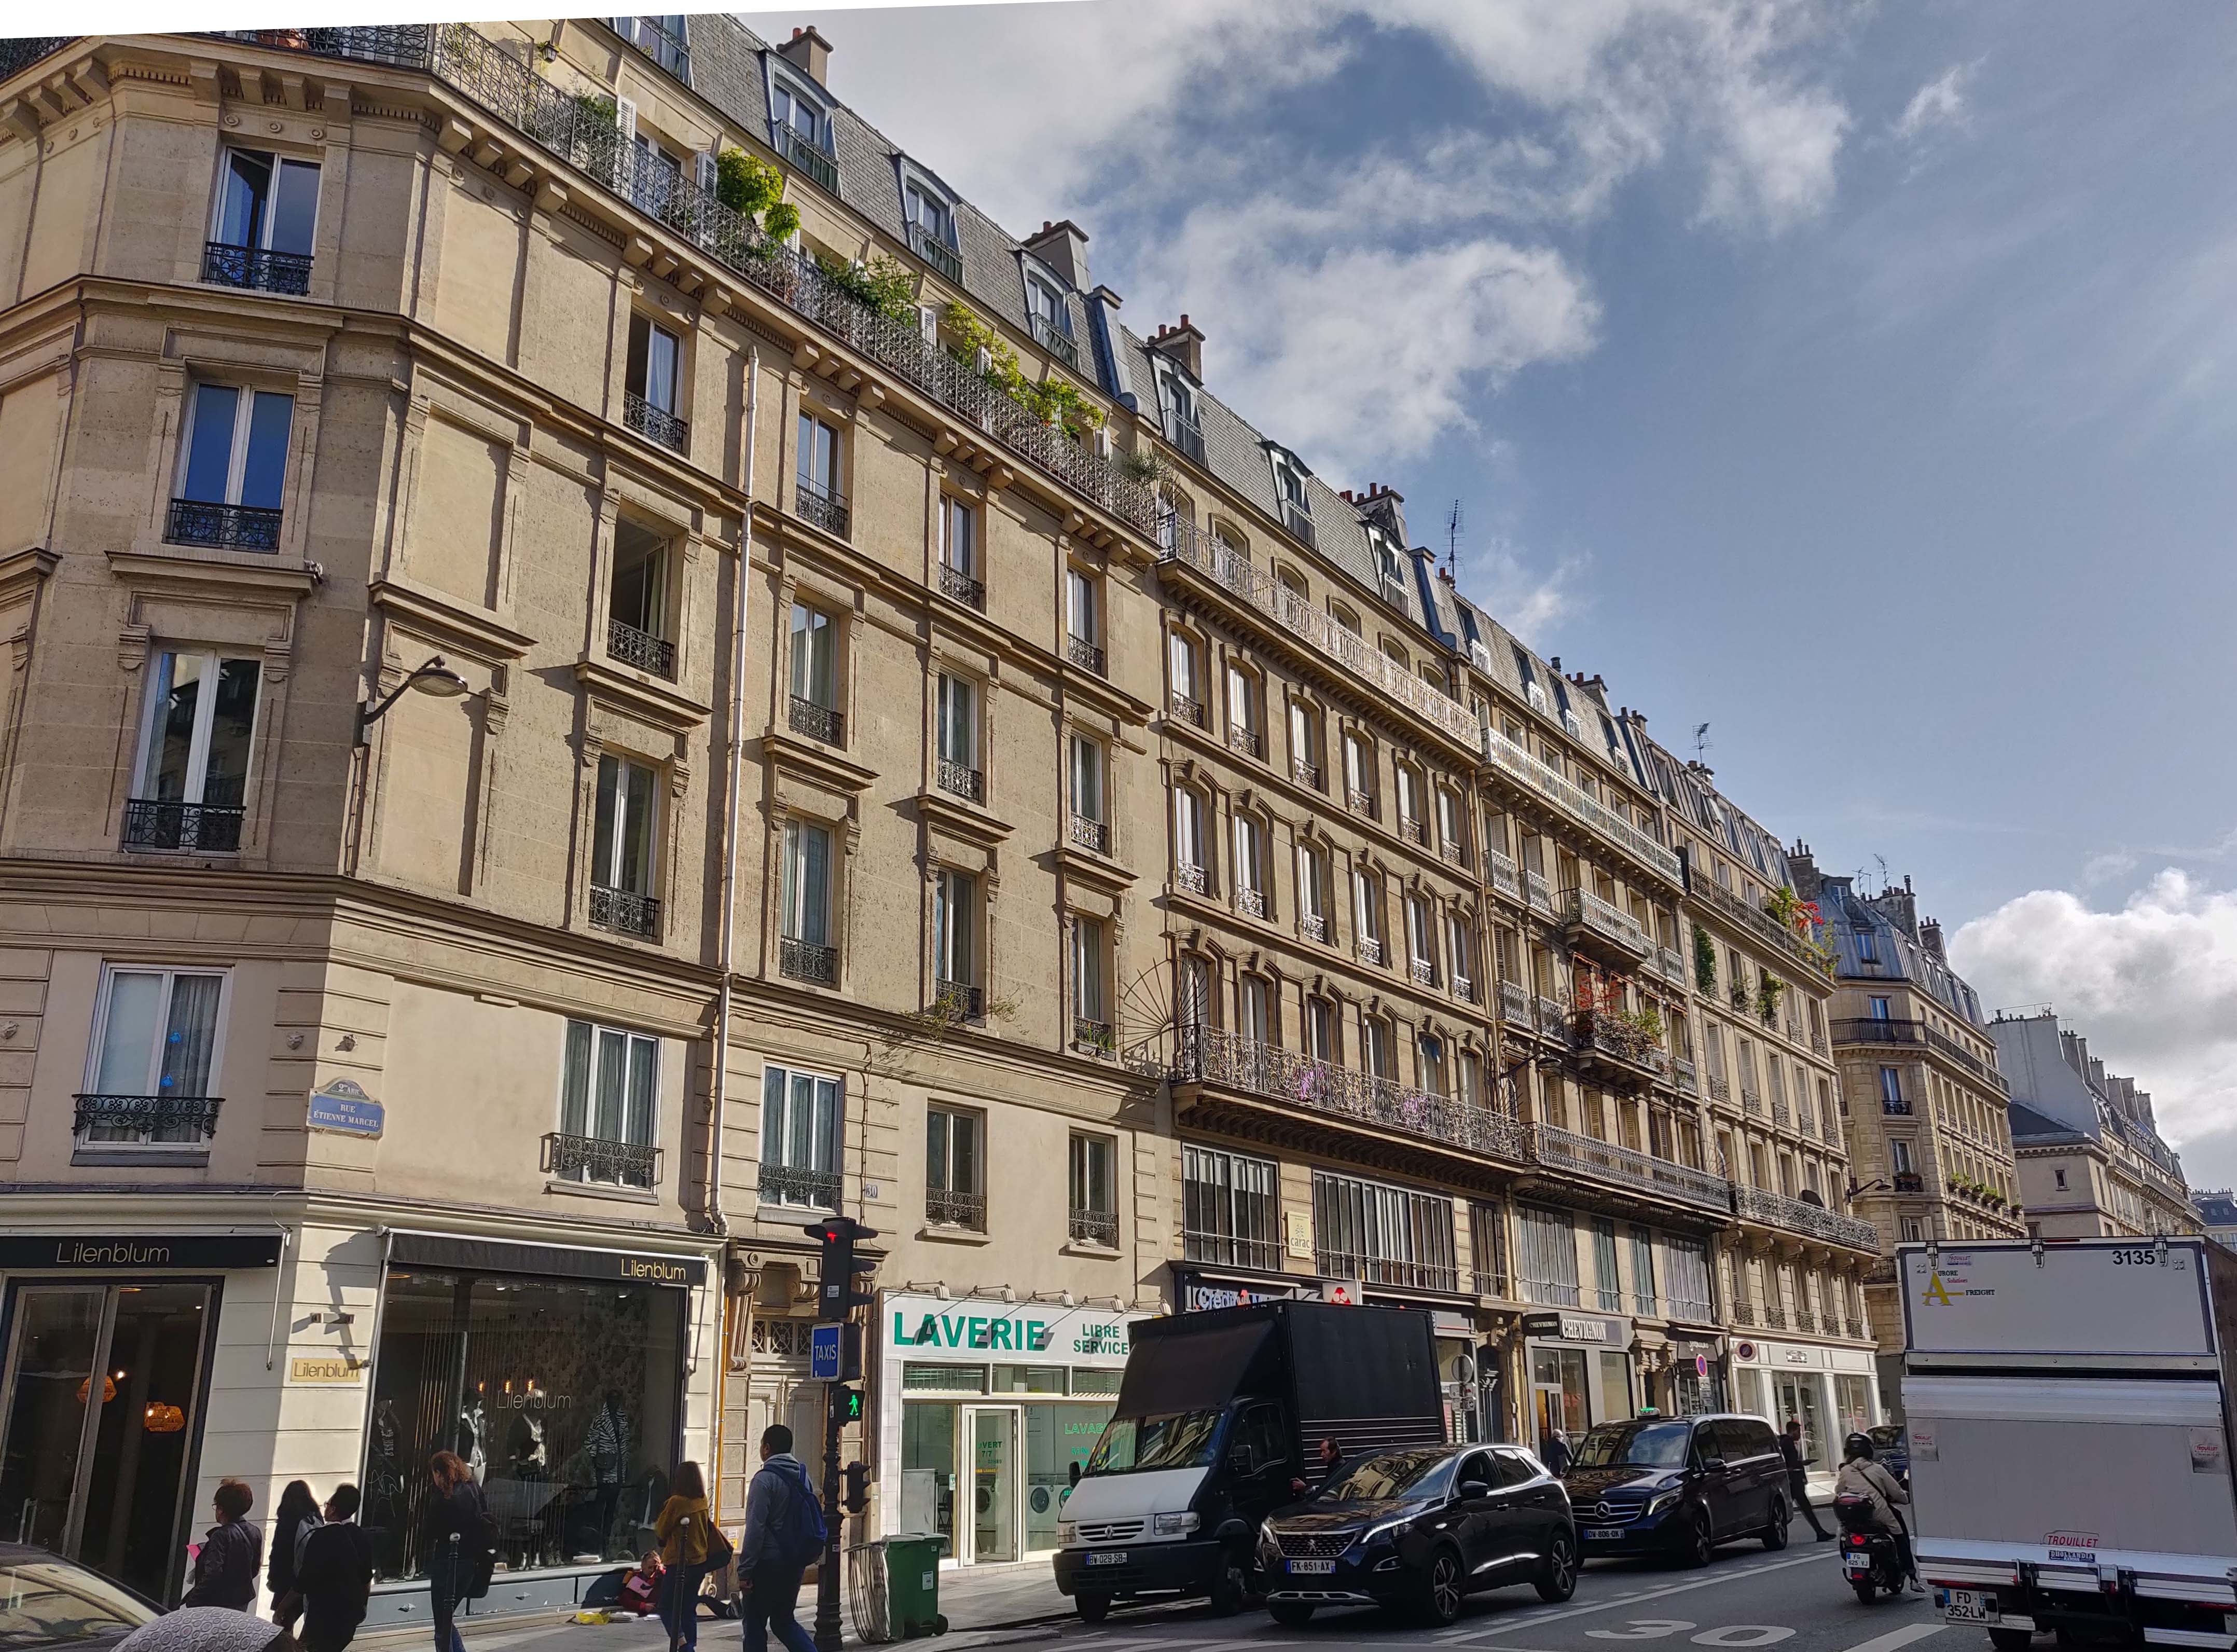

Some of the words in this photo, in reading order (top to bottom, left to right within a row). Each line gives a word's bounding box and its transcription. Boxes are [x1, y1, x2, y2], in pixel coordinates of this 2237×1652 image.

[340, 1104, 355, 1113] RUE
[313, 1109, 346, 1123] ÉTIENNE
[348, 1116, 378, 1127] MARCEL
[866, 1185, 877, 1196] 30
[1291, 1237, 1310, 1248] carac
[56, 1243, 170, 1262] Lilenblum
[2112, 1250, 2155, 1265] 3135
[622, 1258, 686, 1280] Lilenblum
[894, 1312, 1045, 1351] LAVERIE
[1082, 1324, 1120, 1339] LIBRE
[1562, 1319, 1606, 1341] CHEVIGNON
[815, 1344, 837, 1361] TAXIS
[1073, 1339, 1128, 1355] SERVICE
[294, 1362, 358, 1378] Lilenblum
[497, 1389, 571, 1409] Lilenblum
[2048, 1535, 2098, 1548] TROUILLET
[2050, 1551, 2093, 1560] DHOLLANDIA
[1292, 1562, 1330, 1571] FK-851-AX
[1584, 1619, 1797, 1647] 30
